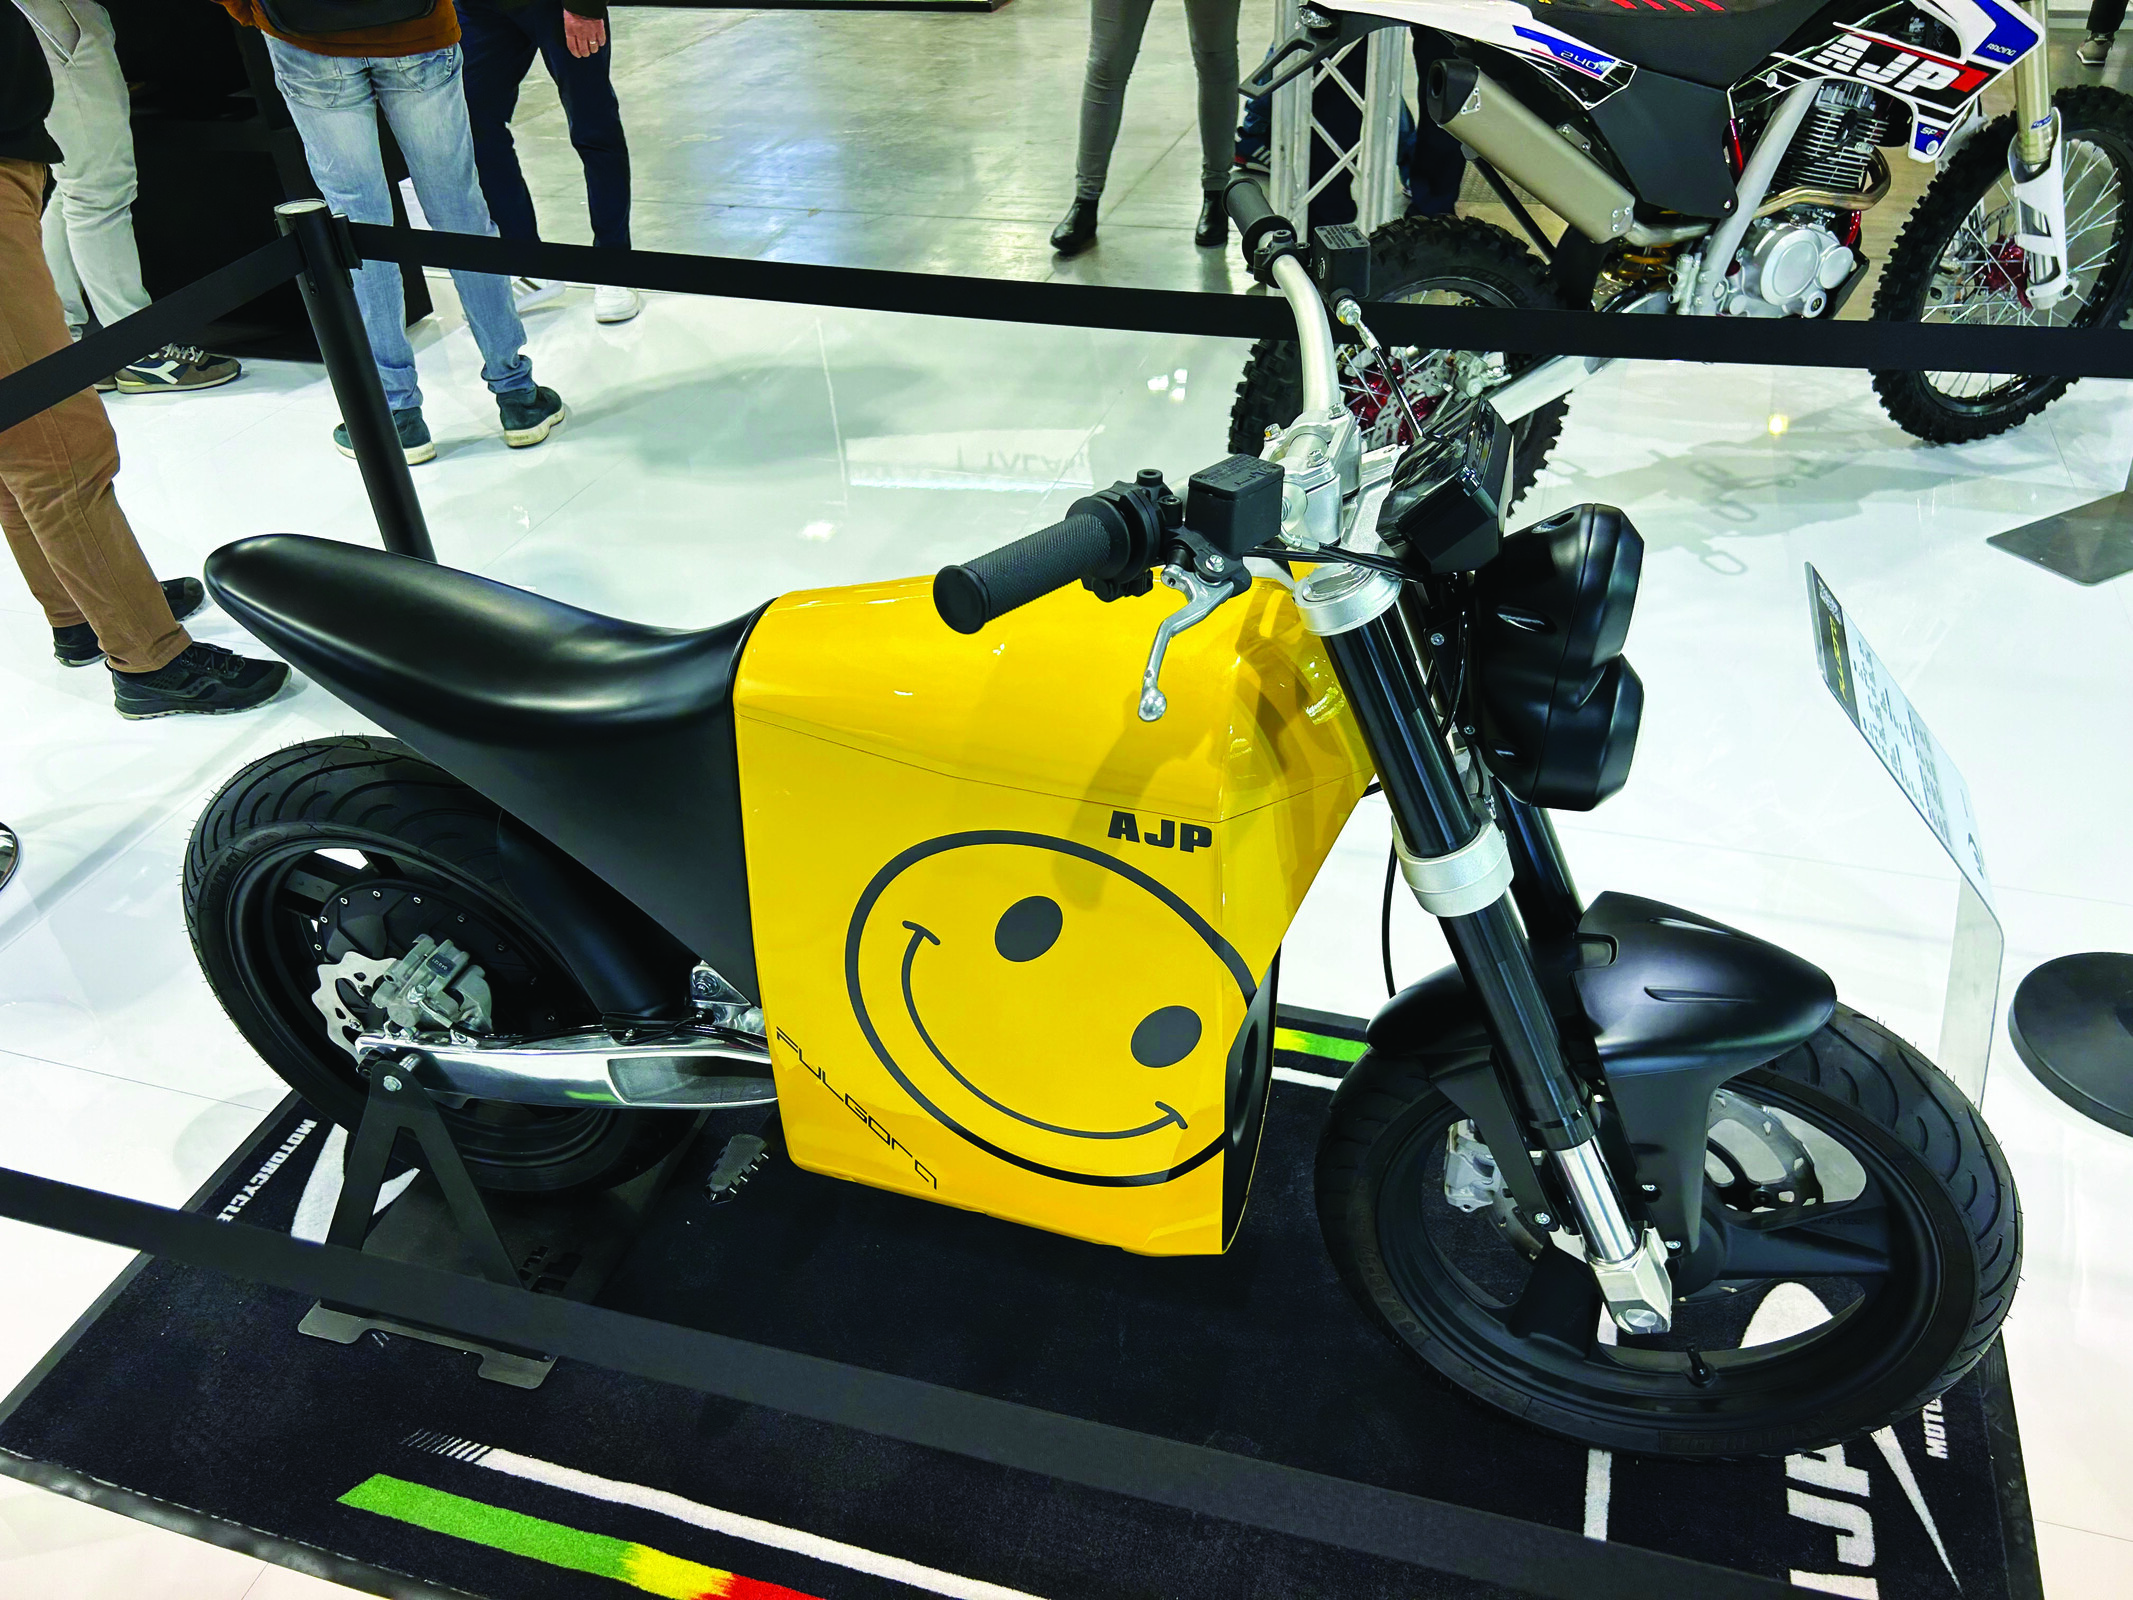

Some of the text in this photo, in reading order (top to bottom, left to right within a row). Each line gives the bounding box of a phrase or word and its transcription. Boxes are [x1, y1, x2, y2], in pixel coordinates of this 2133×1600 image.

[1560, 50, 1599, 71] 240
[1812, 34, 1961, 93] AJP
[1107, 809, 1213, 854] AJP
[776, 1025, 938, 1190] FULGORA
